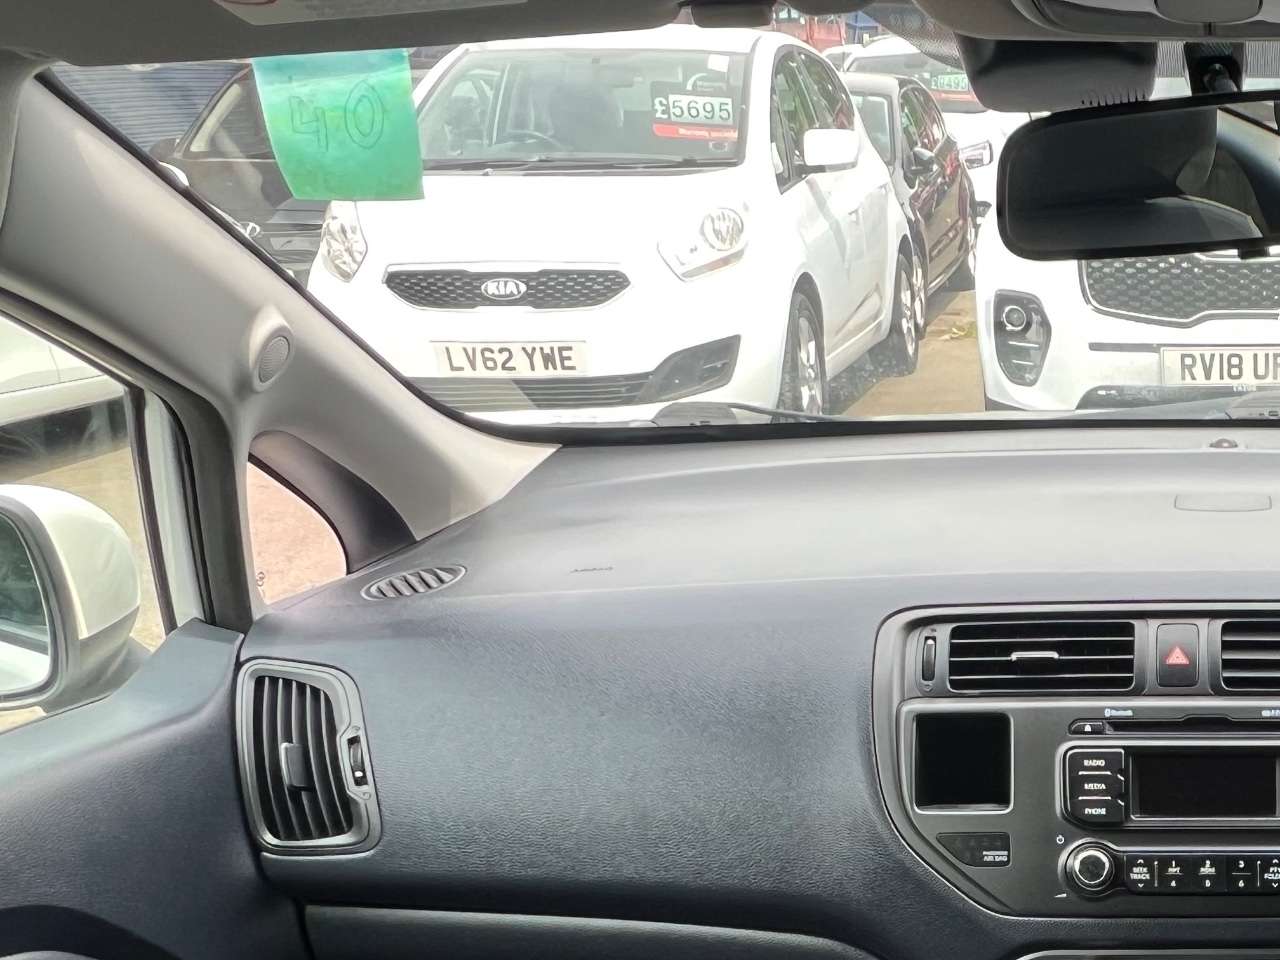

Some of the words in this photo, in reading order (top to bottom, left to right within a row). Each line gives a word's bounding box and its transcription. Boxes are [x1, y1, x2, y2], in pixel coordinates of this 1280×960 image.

[289, 80, 385, 152] 40
[654, 97, 731, 120] £5695
[486, 280, 523, 297] KIA
[445, 346, 516, 372] LV62
[521, 346, 577, 371] YWE
[1180, 353, 1243, 381] RV18
